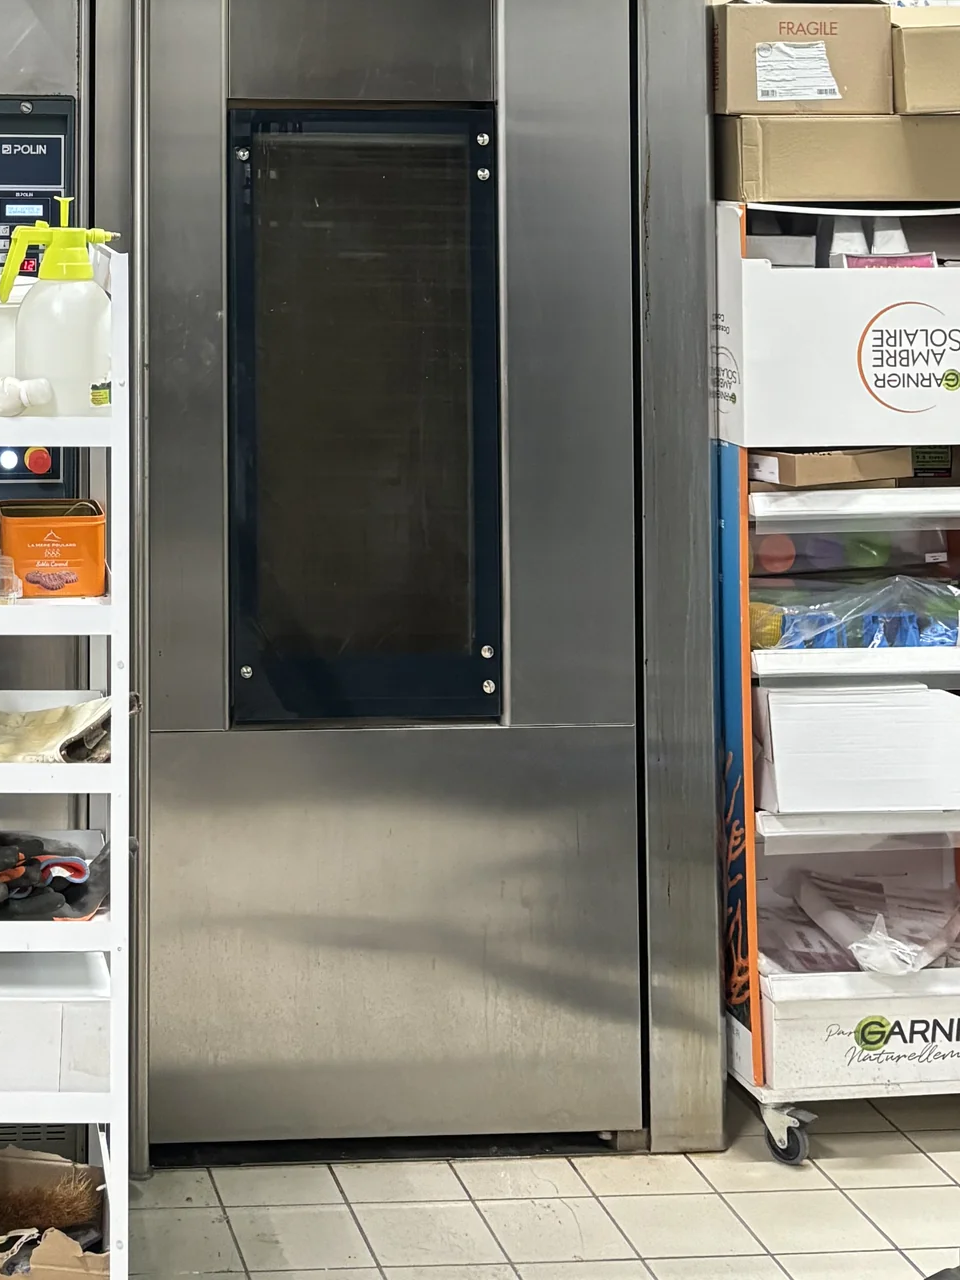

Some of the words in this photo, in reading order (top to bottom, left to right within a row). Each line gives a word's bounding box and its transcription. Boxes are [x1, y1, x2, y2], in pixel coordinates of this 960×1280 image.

[779, 21, 838, 36] FRAGILE
[13, 144, 47, 155] POLIN
[872, 329, 960, 351] SOLAIRE
[872, 349, 946, 367] AMBRE
[874, 372, 959, 388] GARNIER
